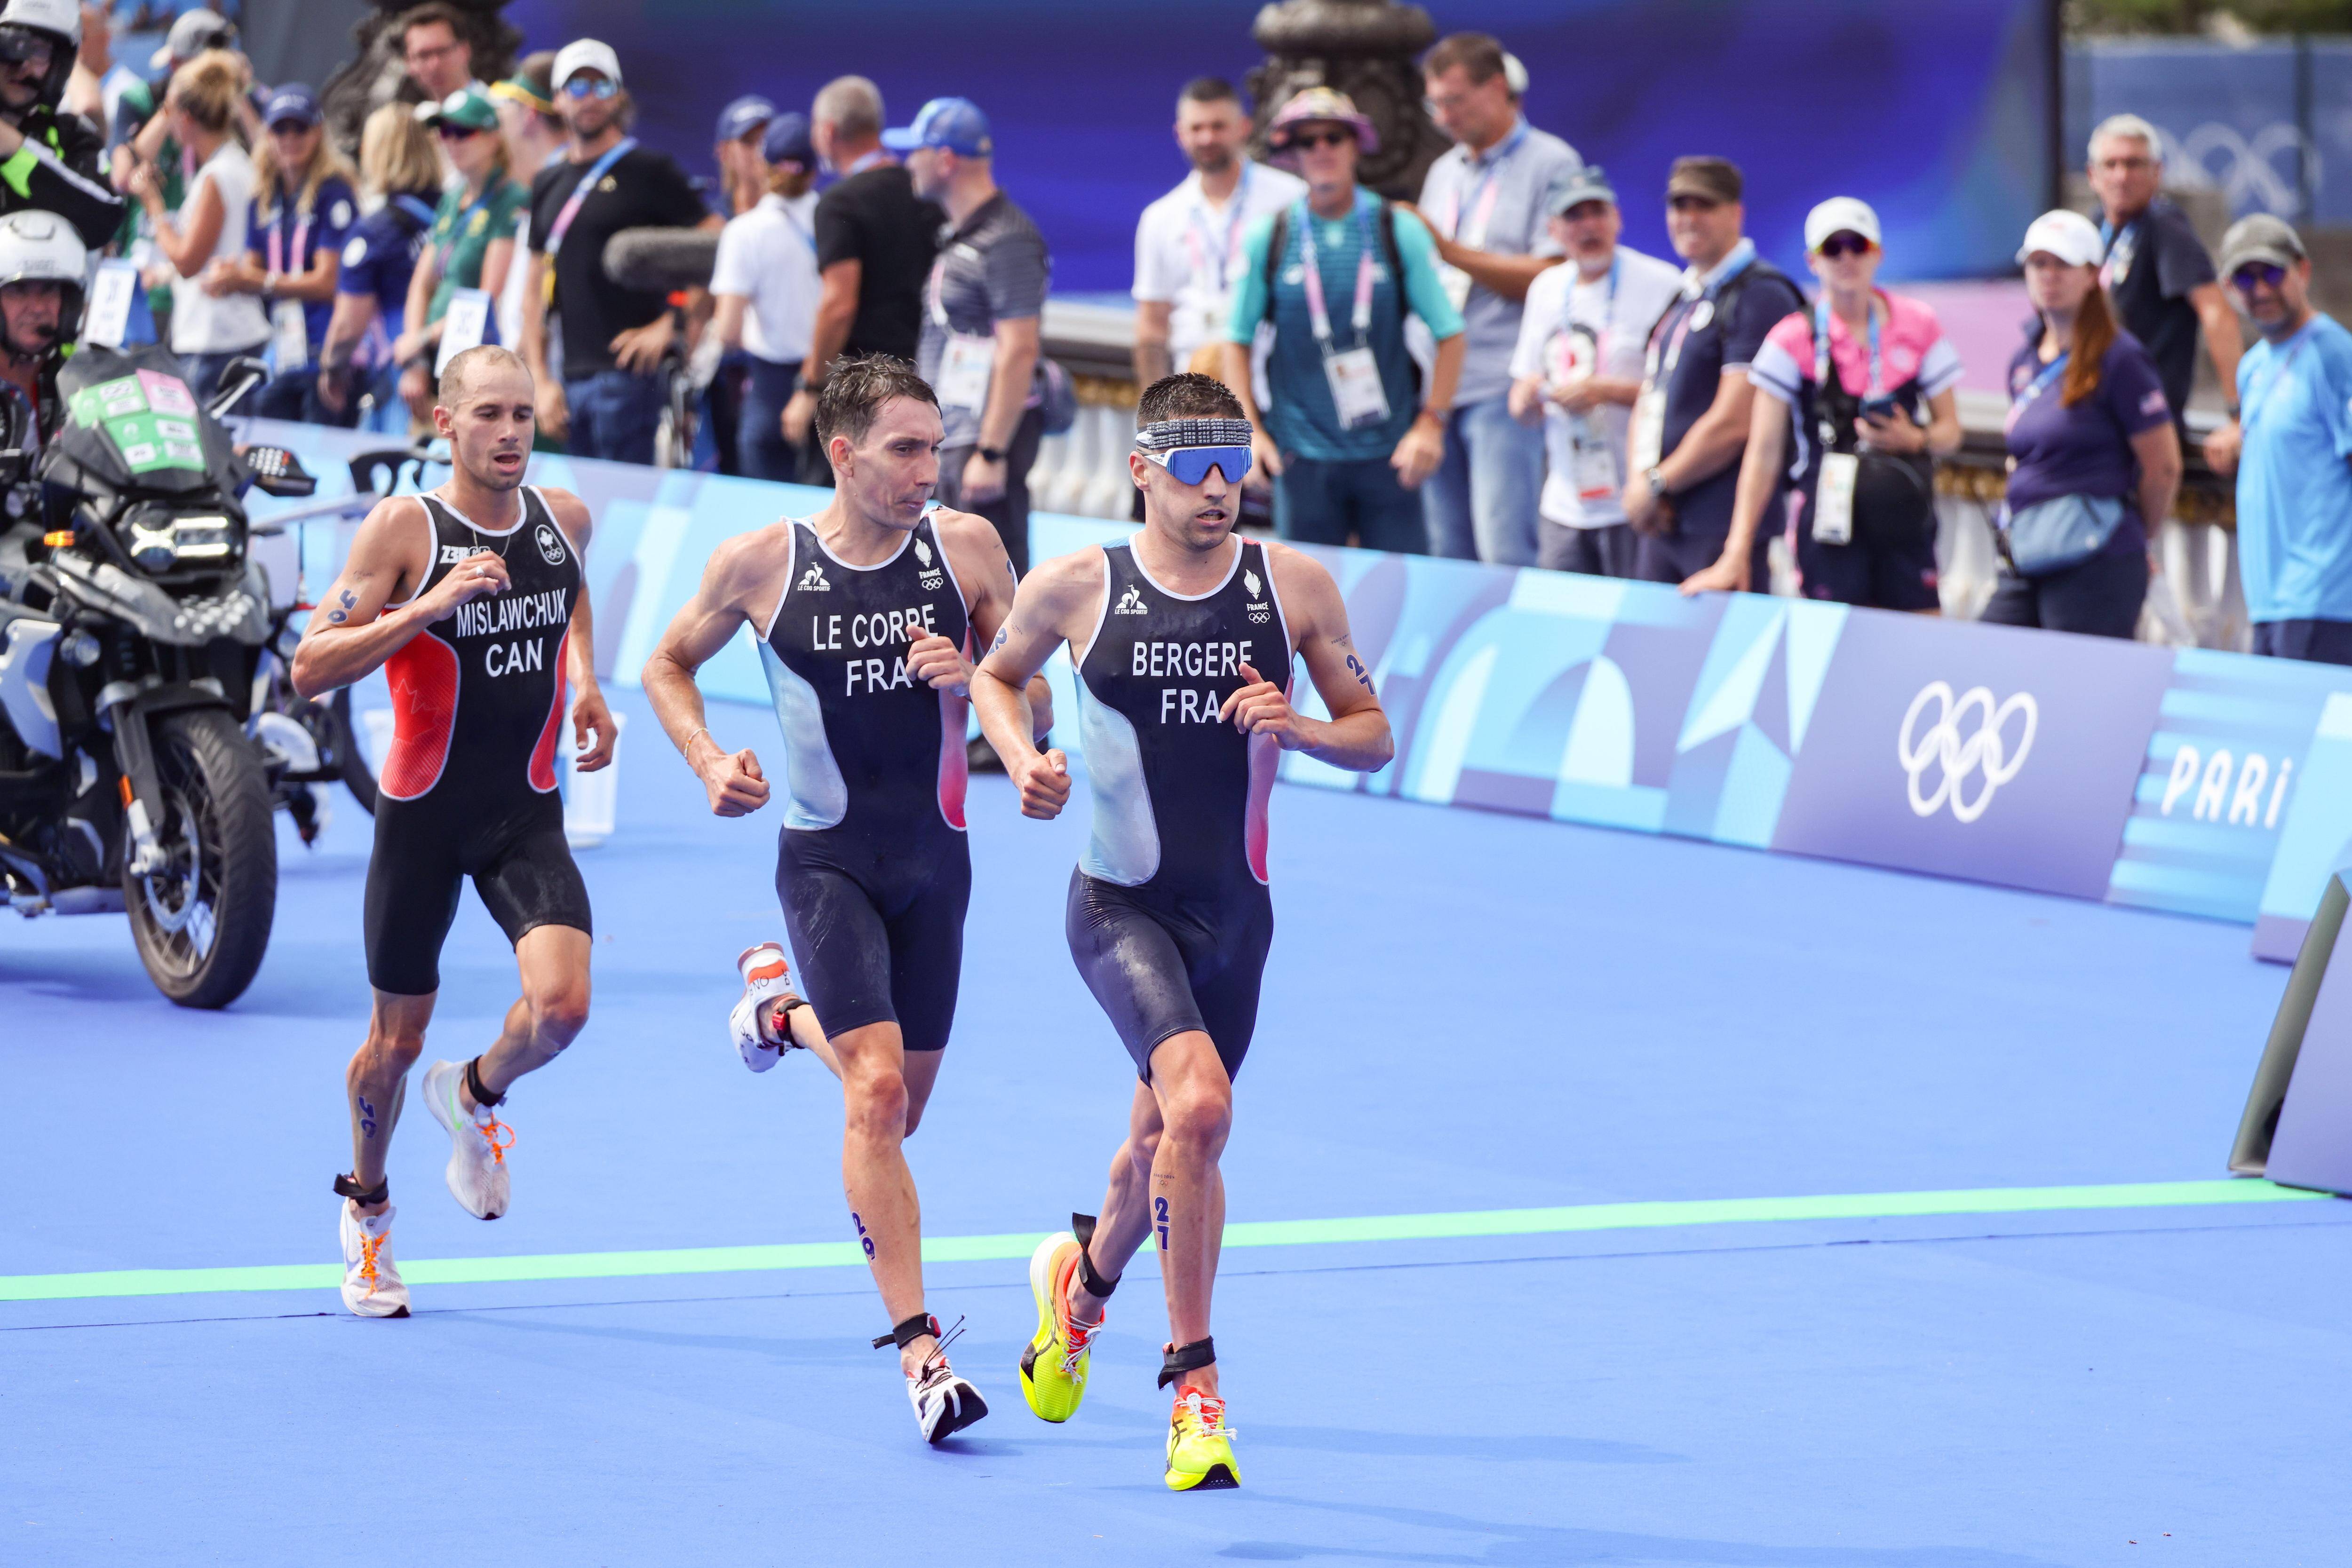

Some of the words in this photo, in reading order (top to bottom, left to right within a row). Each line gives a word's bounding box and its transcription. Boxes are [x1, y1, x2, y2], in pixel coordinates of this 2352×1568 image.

[918, 567, 942, 579] FRANCE
[457, 587, 566, 638] MISLAWCHUK
[813, 615, 842, 650] LE
[851, 603, 938, 648] CORRE
[1246, 602, 1269, 611] FRANCE
[485, 637, 544, 678] CAN
[846, 656, 914, 697] FRA
[1346, 654, 1375, 696] 27
[1160, 688, 1223, 724] FRA
[851, 1211, 876, 1261] 29
[1154, 1196, 1170, 1251] 27
